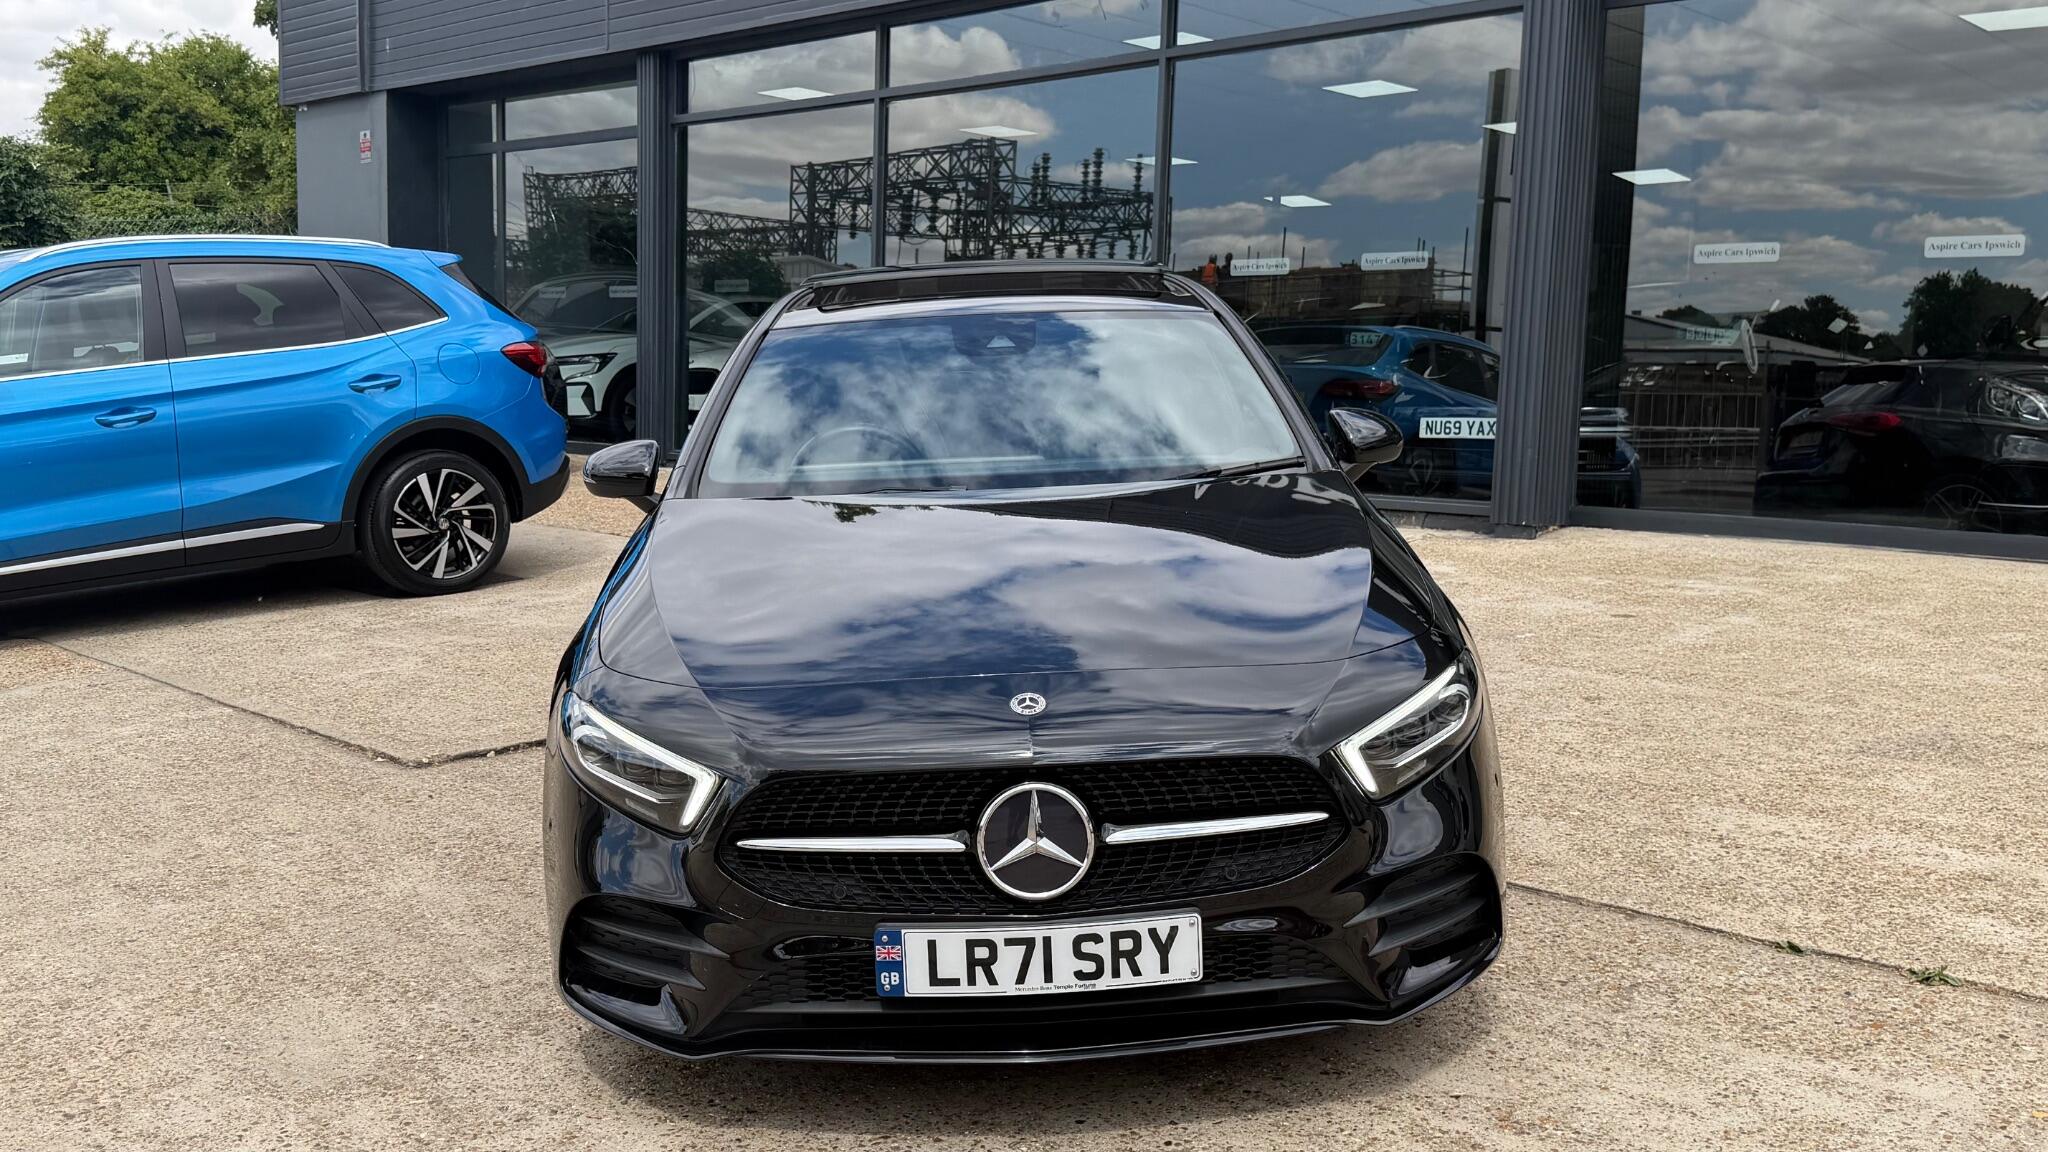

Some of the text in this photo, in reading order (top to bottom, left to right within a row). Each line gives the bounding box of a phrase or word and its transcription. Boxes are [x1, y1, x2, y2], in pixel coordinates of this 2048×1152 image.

[1928, 240, 2021, 252] Aspire Cars Ipswich
[1698, 247, 1777, 259] Aspire Cars Ipswich
[1425, 420, 1496, 436] NU69 YAX
[927, 925, 1179, 987] LR71 SRY
[880, 972, 900, 985] GB
